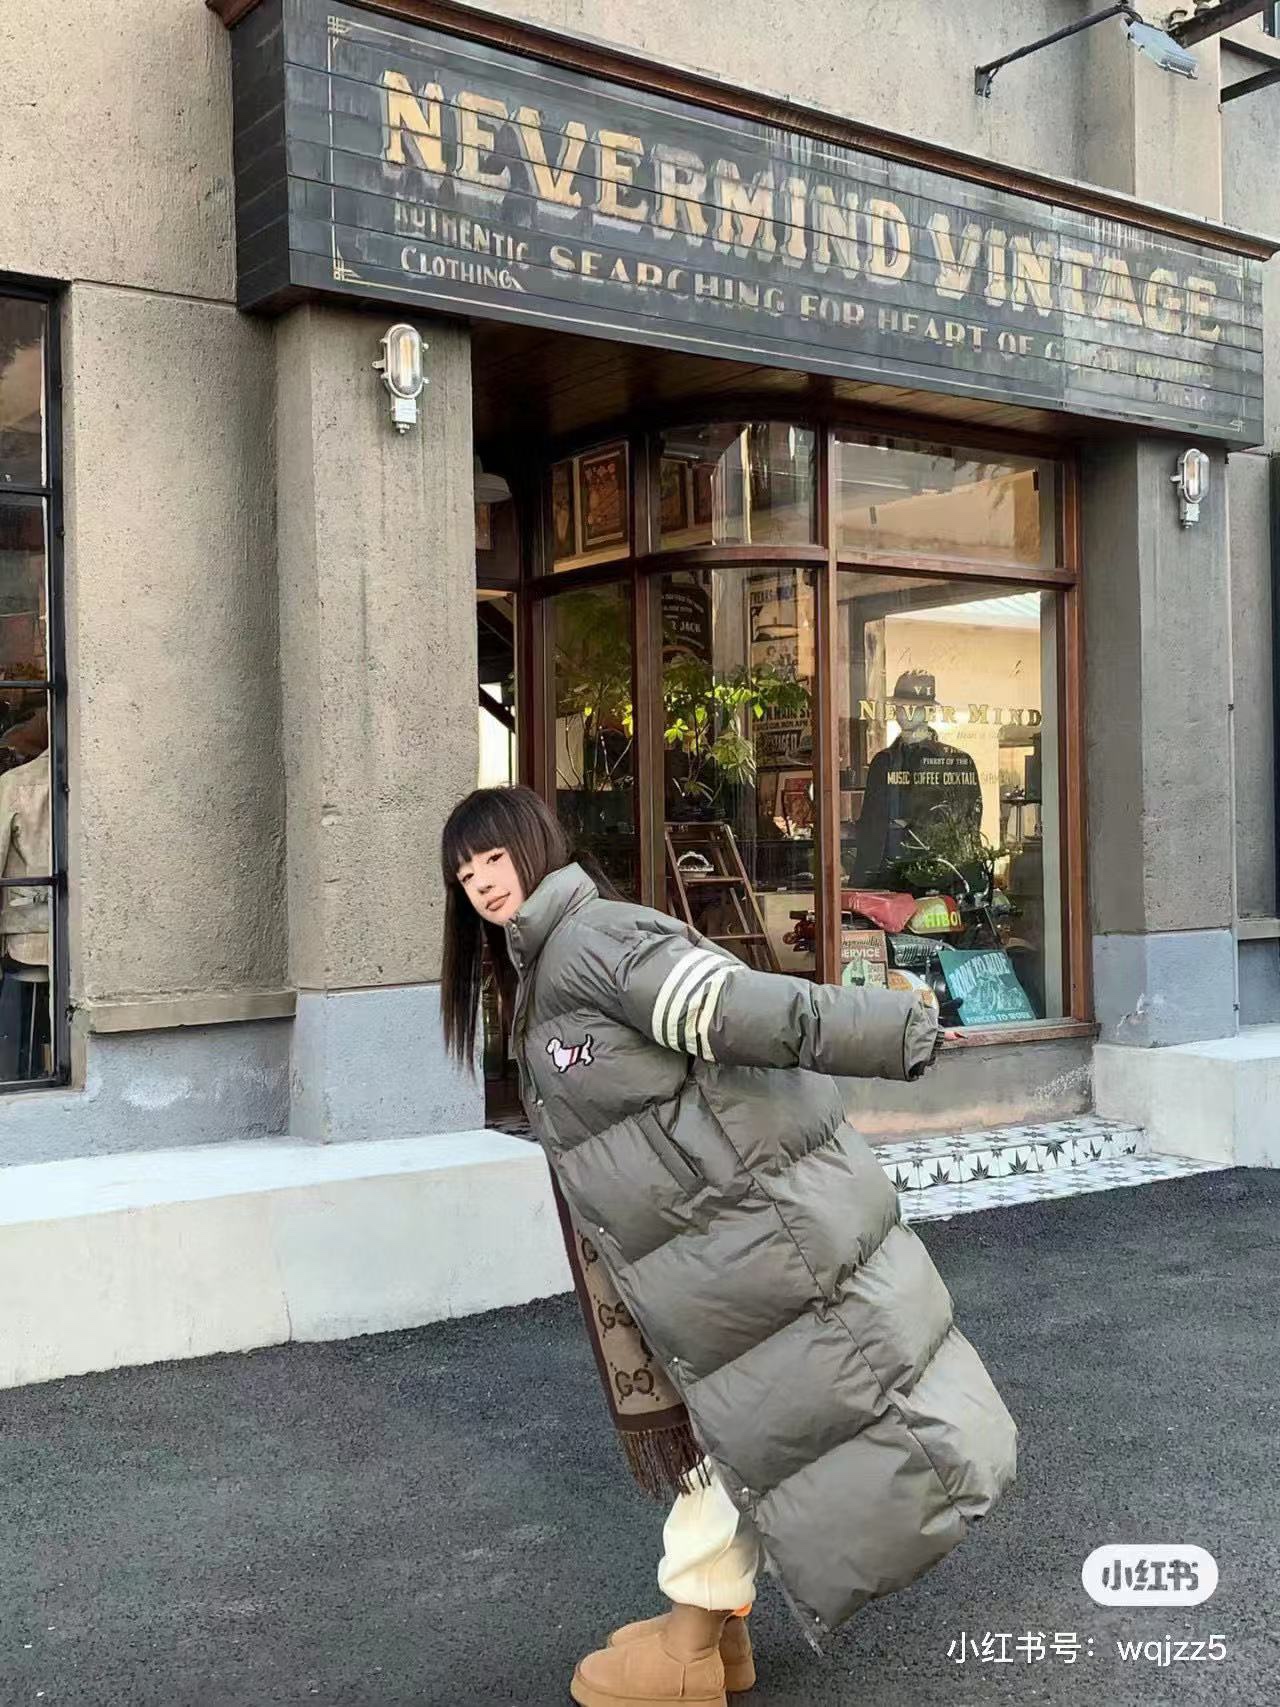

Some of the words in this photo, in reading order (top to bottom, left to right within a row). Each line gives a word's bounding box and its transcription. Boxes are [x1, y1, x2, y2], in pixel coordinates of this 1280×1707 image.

[381, 70, 912, 285] NEVERMIND
[926, 212, 1221, 346] VINTAGE
[400, 245, 527, 292] CLOTHING
[550, 245, 785, 317] SEARCHING
[800, 295, 865, 327] FOR
[878, 308, 988, 353] HEART
[998, 331, 1035, 360] OF
[859, 700, 957, 724] NEVER
[968, 704, 1042, 727] MIND
[887, 770, 911, 785] MUSIC
[913, 771, 940, 785] COFFEE
[942, 771, 977, 785] COCKTAIL
